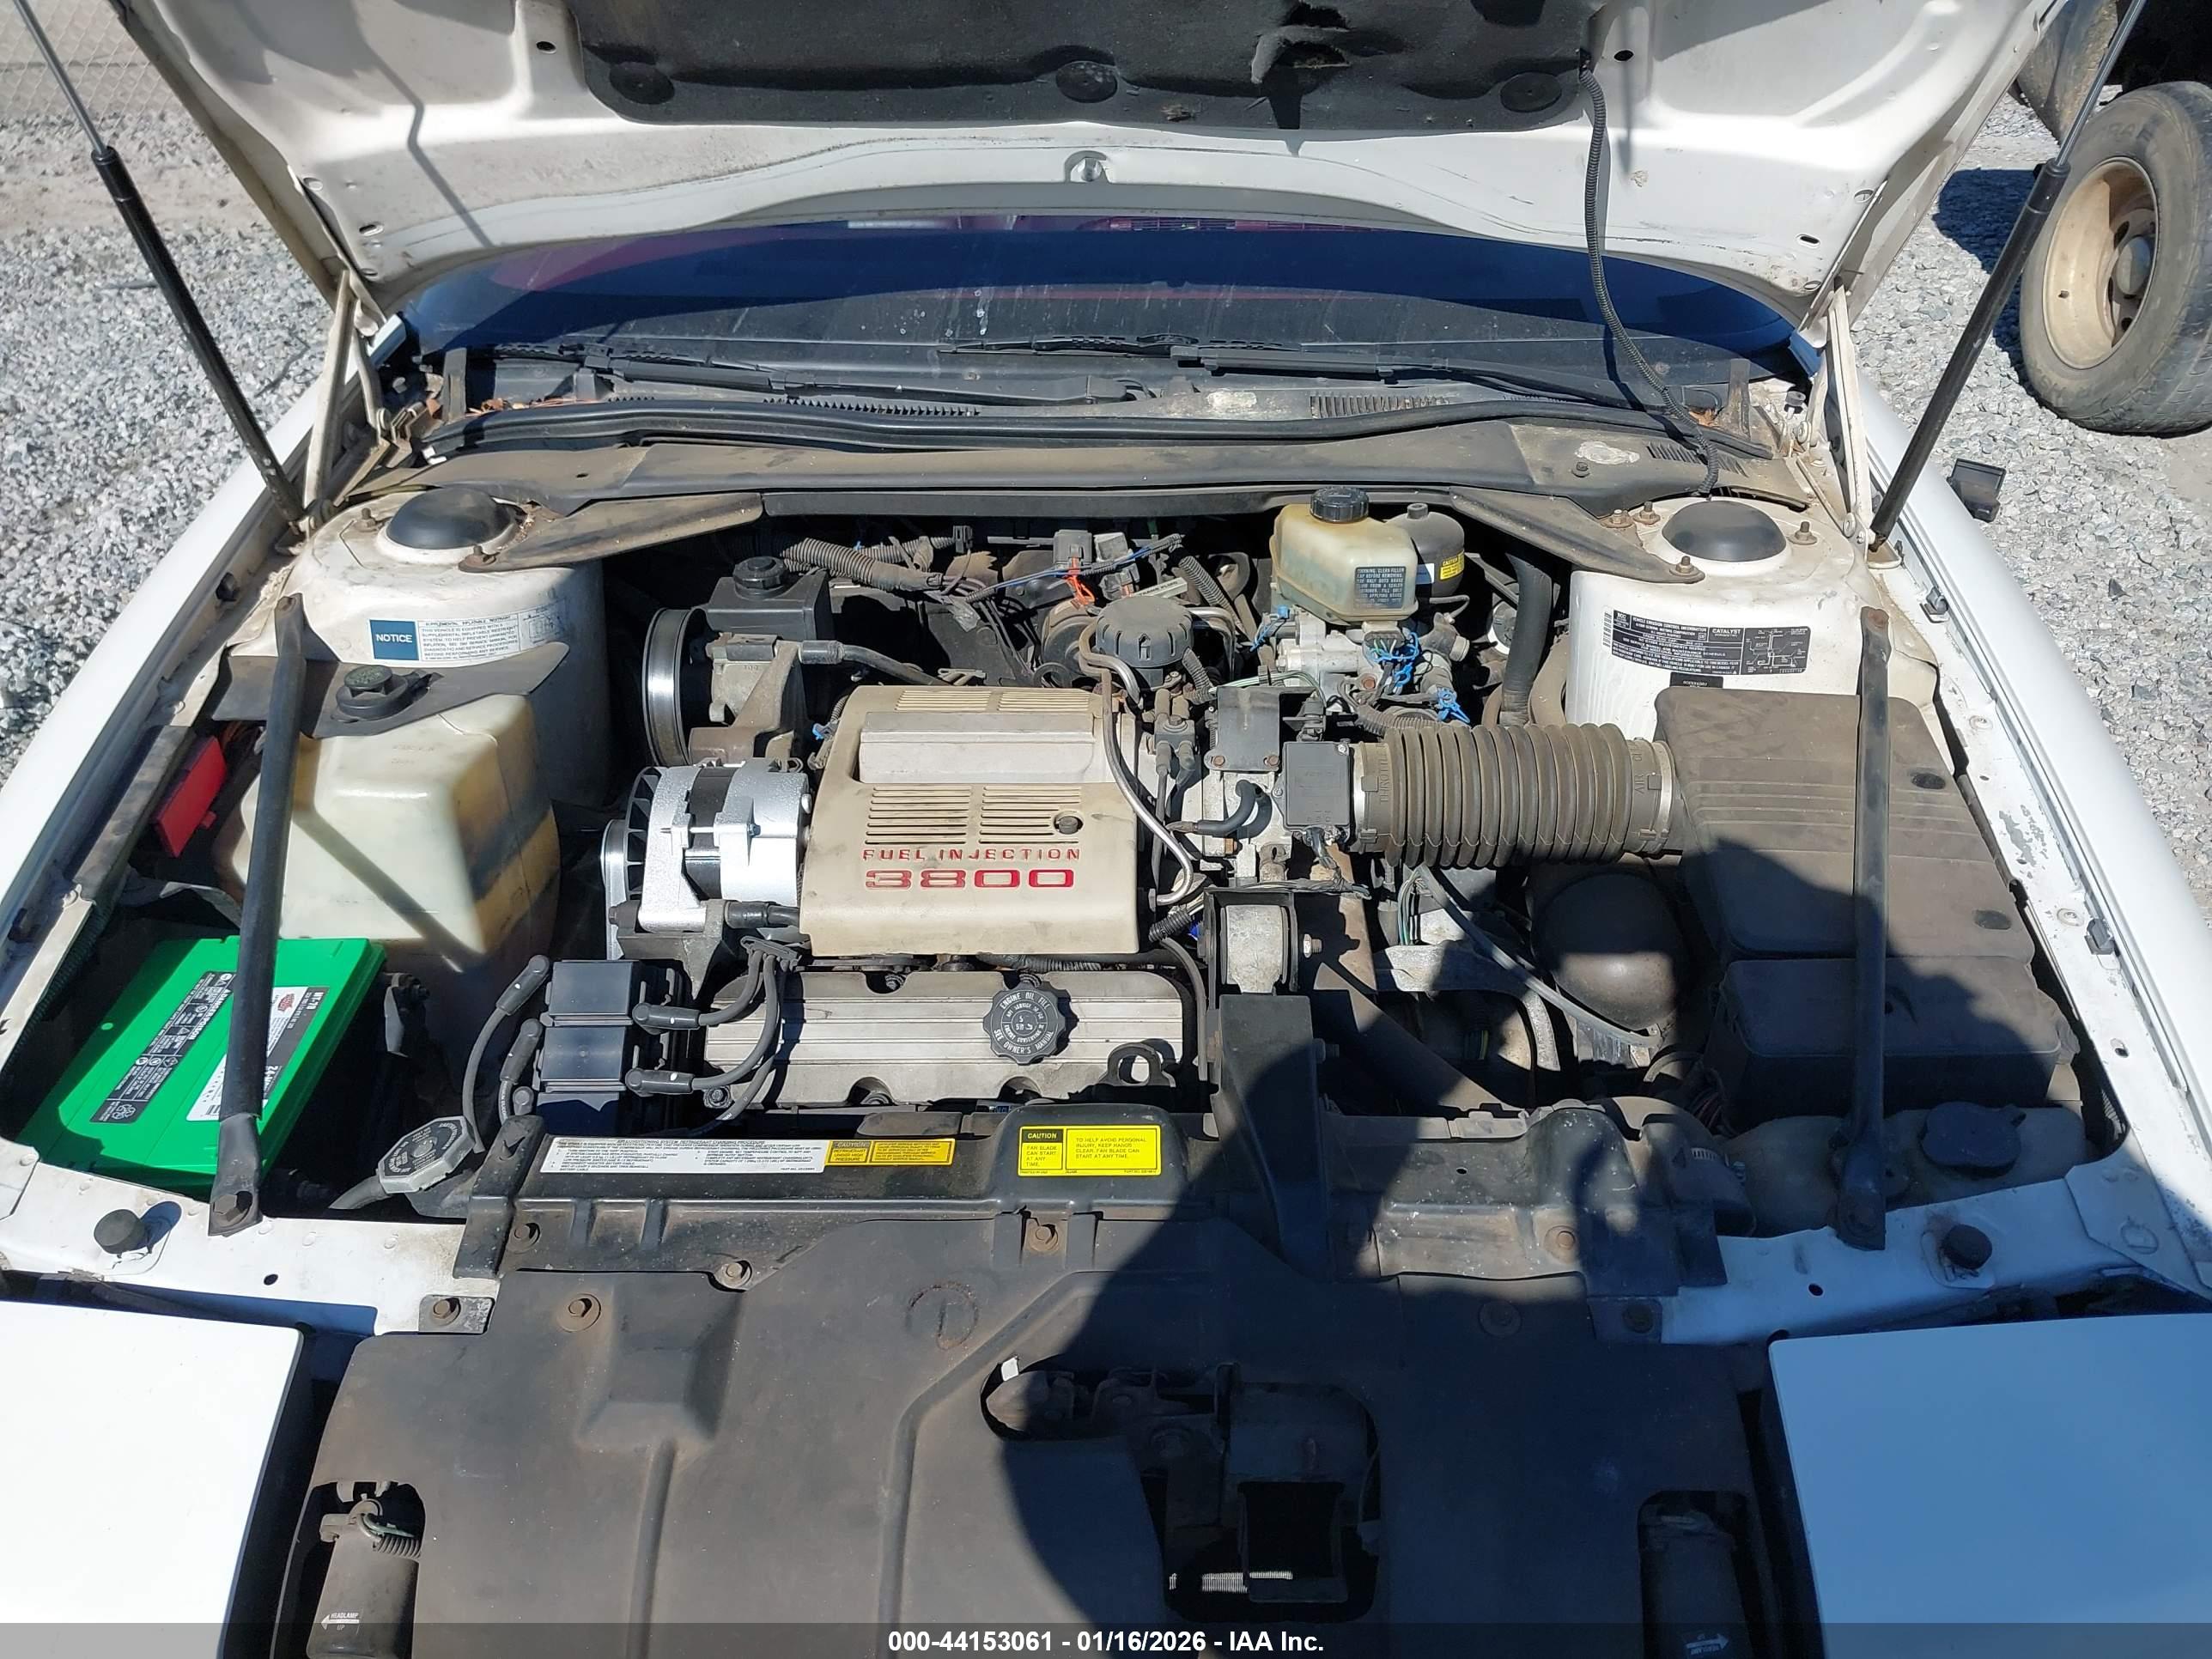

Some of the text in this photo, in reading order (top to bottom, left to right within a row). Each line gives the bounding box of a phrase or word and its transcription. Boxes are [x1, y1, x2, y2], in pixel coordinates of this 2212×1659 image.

[375, 634, 413, 643] NOTICE
[862, 848, 1080, 860] FUEL INJECTION
[865, 869, 1075, 889] 3800
[1000, 992, 1022, 1010] ENGINE
[1037, 996, 1051, 1010] FILL
[994, 1029, 1054, 1054] SEE OWNER'S MANUAL
